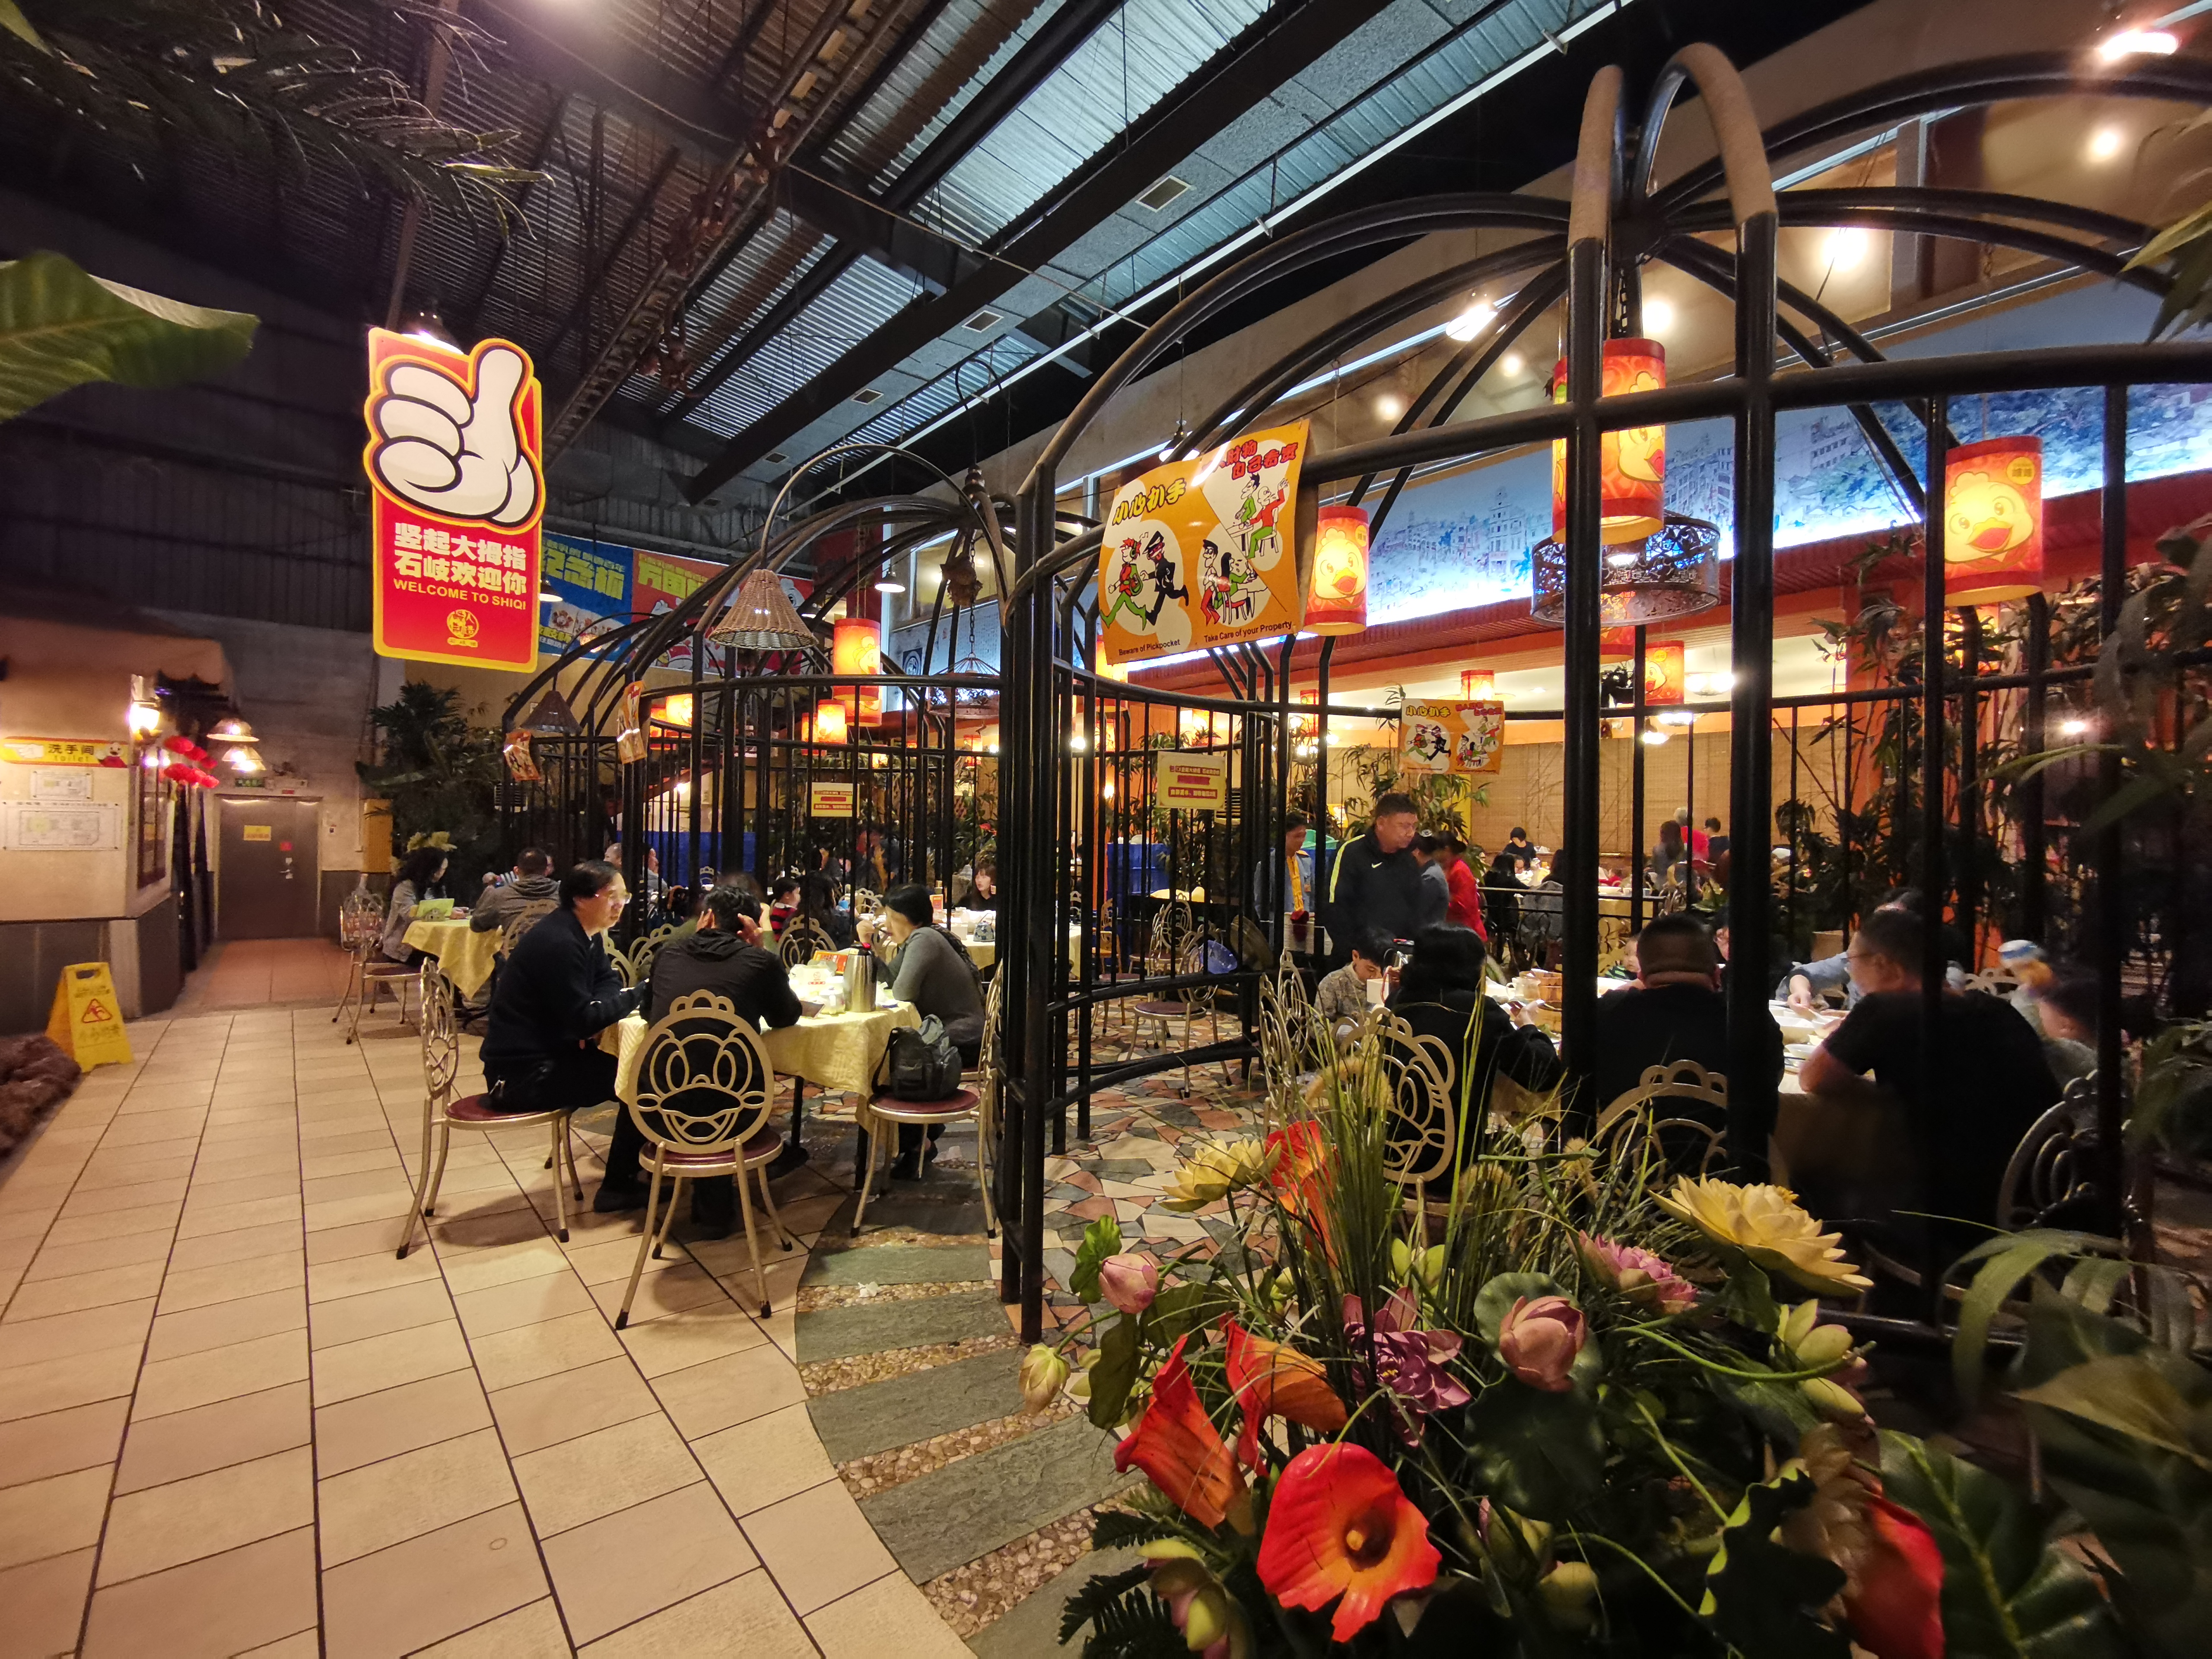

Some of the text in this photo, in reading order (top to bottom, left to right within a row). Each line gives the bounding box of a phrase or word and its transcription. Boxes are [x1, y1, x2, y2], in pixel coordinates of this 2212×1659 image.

[1112, 477, 1187, 526] 小心扒手
[394, 522, 526, 571] 竖起大拇指
[394, 550, 527, 596] 石岐欢迎你
[393, 577, 526, 610] WELCOME TO SHIQI
[1236, 629, 1242, 637] of
[1243, 627, 1259, 638] your
[1260, 621, 1292, 632] Property
[1119, 647, 1139, 656] Beware
[1146, 639, 1181, 651] Pickpocket
[48, 744, 95, 755] 洗手间
